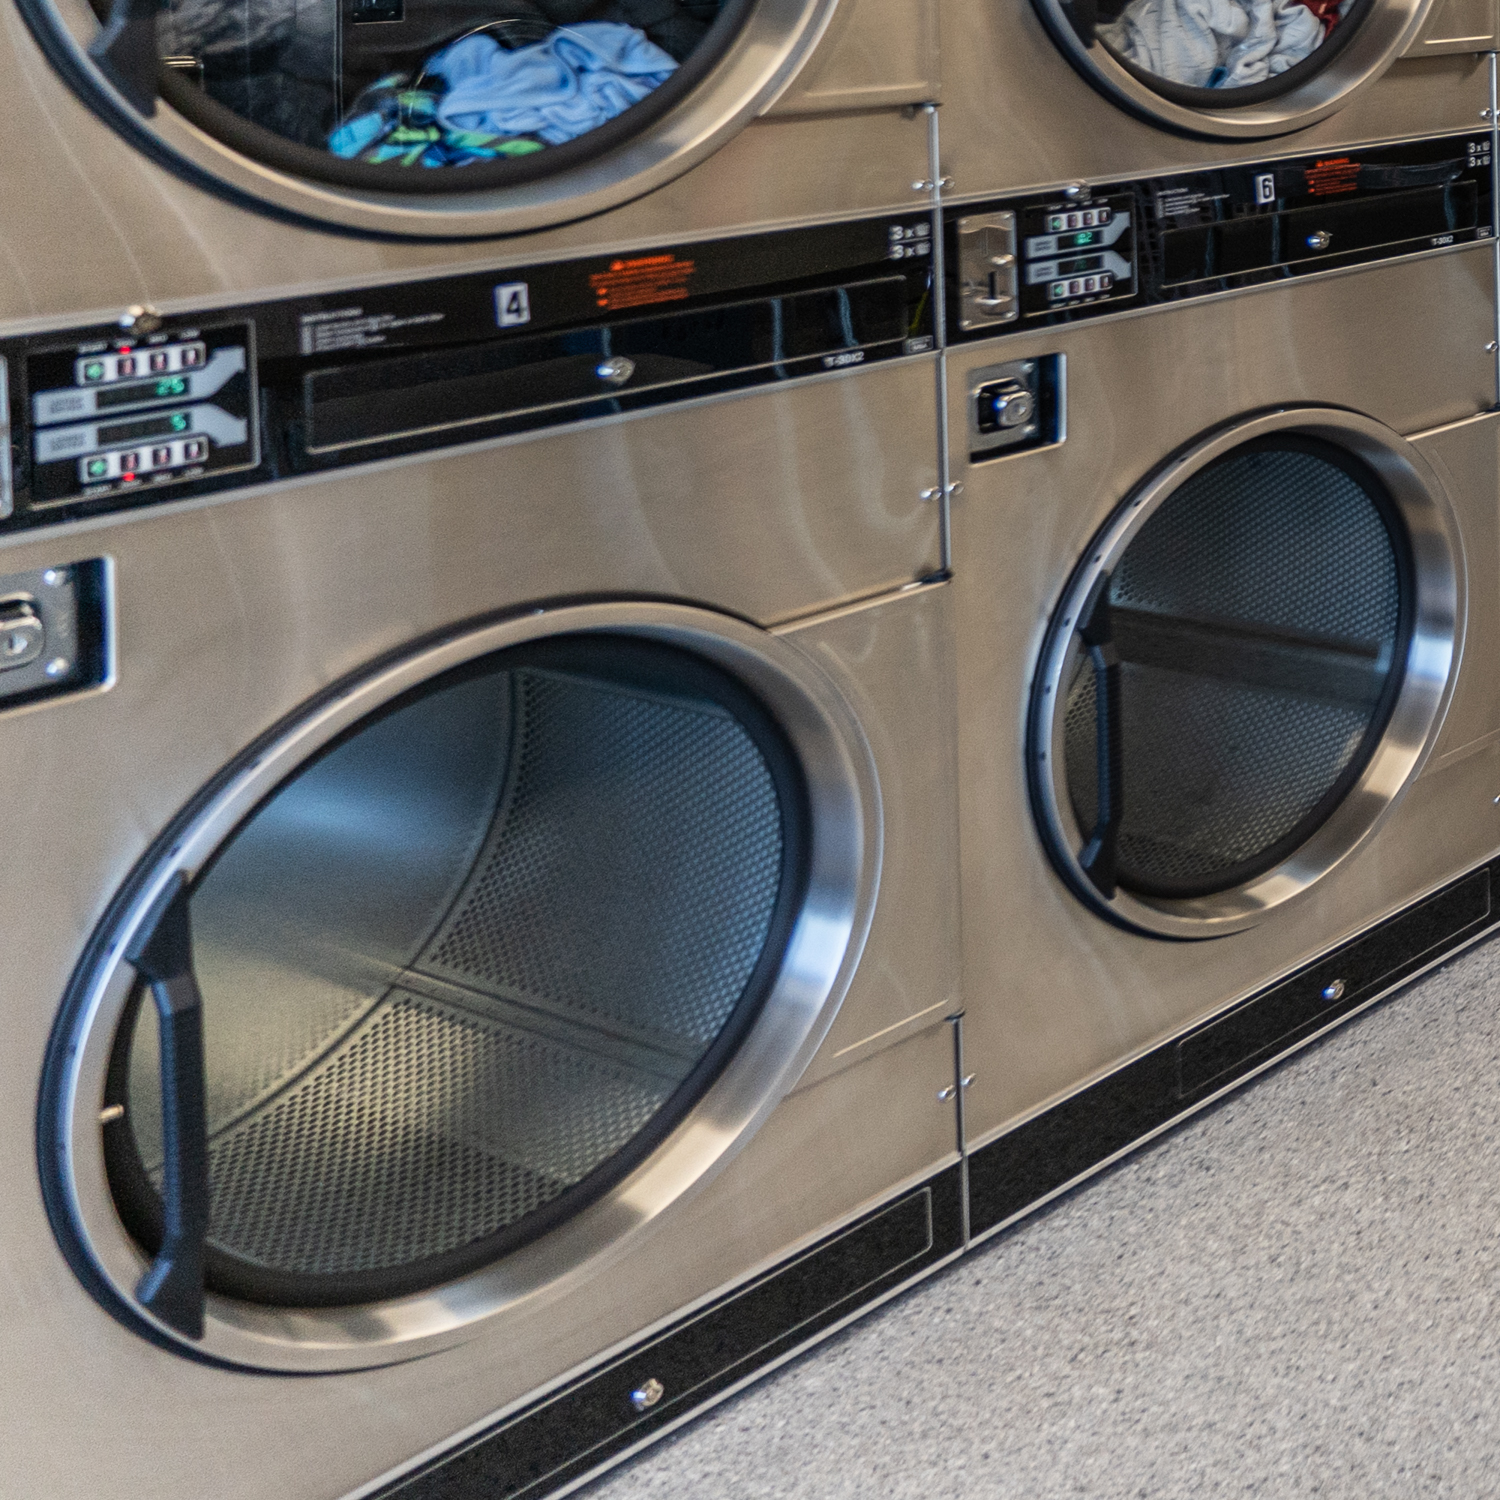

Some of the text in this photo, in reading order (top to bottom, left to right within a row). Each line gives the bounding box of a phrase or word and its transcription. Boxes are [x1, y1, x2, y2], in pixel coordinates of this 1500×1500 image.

[1468, 142, 1476, 153] 3
[1468, 156, 1476, 167] 3
[890, 225, 903, 240] 3
[890, 244, 904, 260] 3
